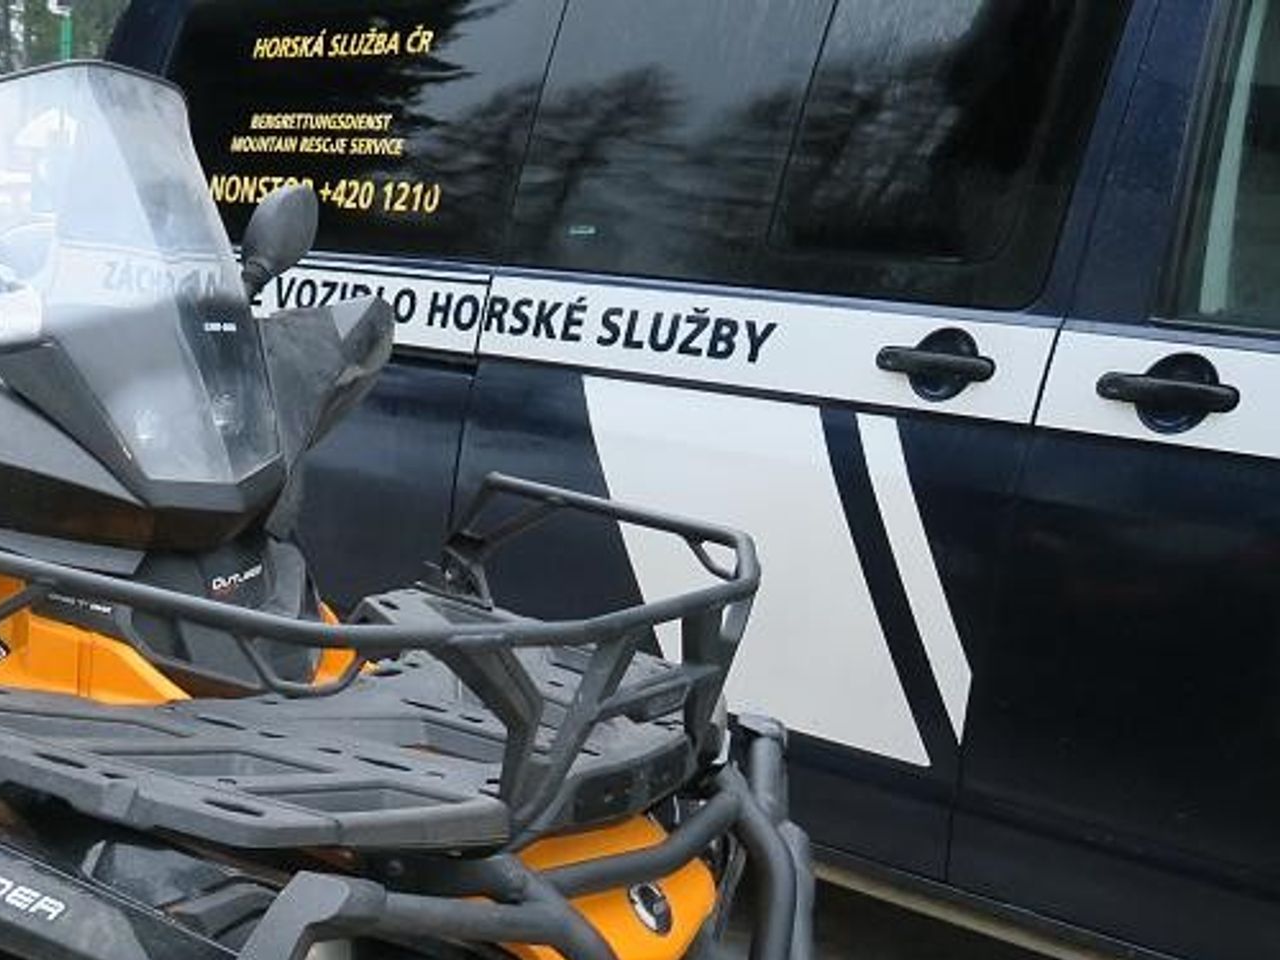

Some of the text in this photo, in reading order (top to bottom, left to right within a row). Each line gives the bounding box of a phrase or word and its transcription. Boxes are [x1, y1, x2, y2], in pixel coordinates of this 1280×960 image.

[252, 25, 434, 60] HORSKÁ SLUŽBA ČR
[250, 113, 393, 131] BERGRETTUNGSDIENST
[230, 136, 299, 153] MOUNTAIN
[349, 138, 406, 156] SERVICE
[319, 178, 375, 210] +420
[383, 182, 440, 214] 1210
[426, 289, 587, 343] HORSKÉ
[596, 306, 778, 364] SLUŽBY
